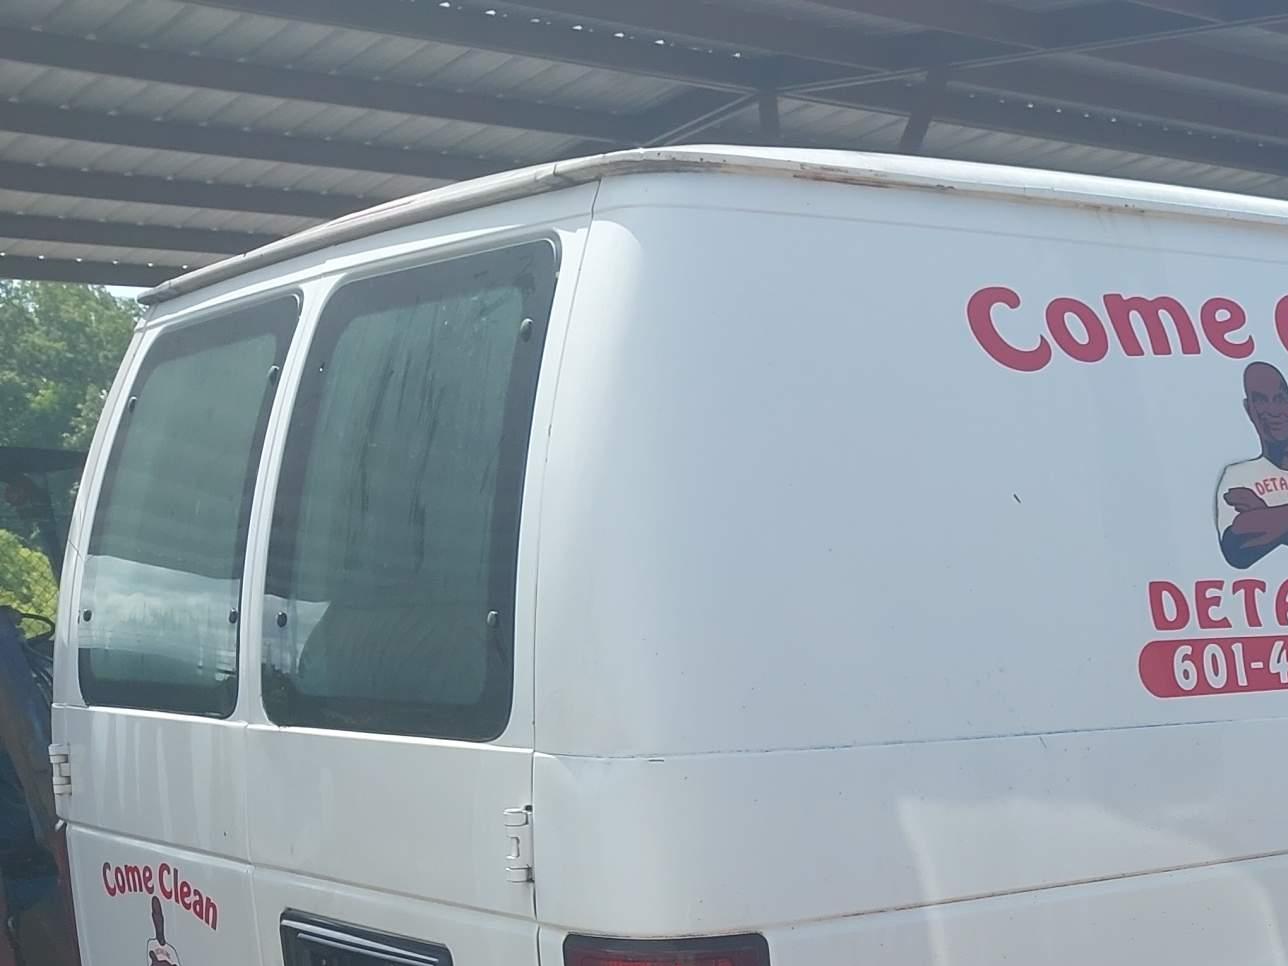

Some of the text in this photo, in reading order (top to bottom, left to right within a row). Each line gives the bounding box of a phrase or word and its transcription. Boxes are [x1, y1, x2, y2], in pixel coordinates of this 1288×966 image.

[966, 285, 1255, 373] Come
[103, 862, 217, 931] Come Clean
